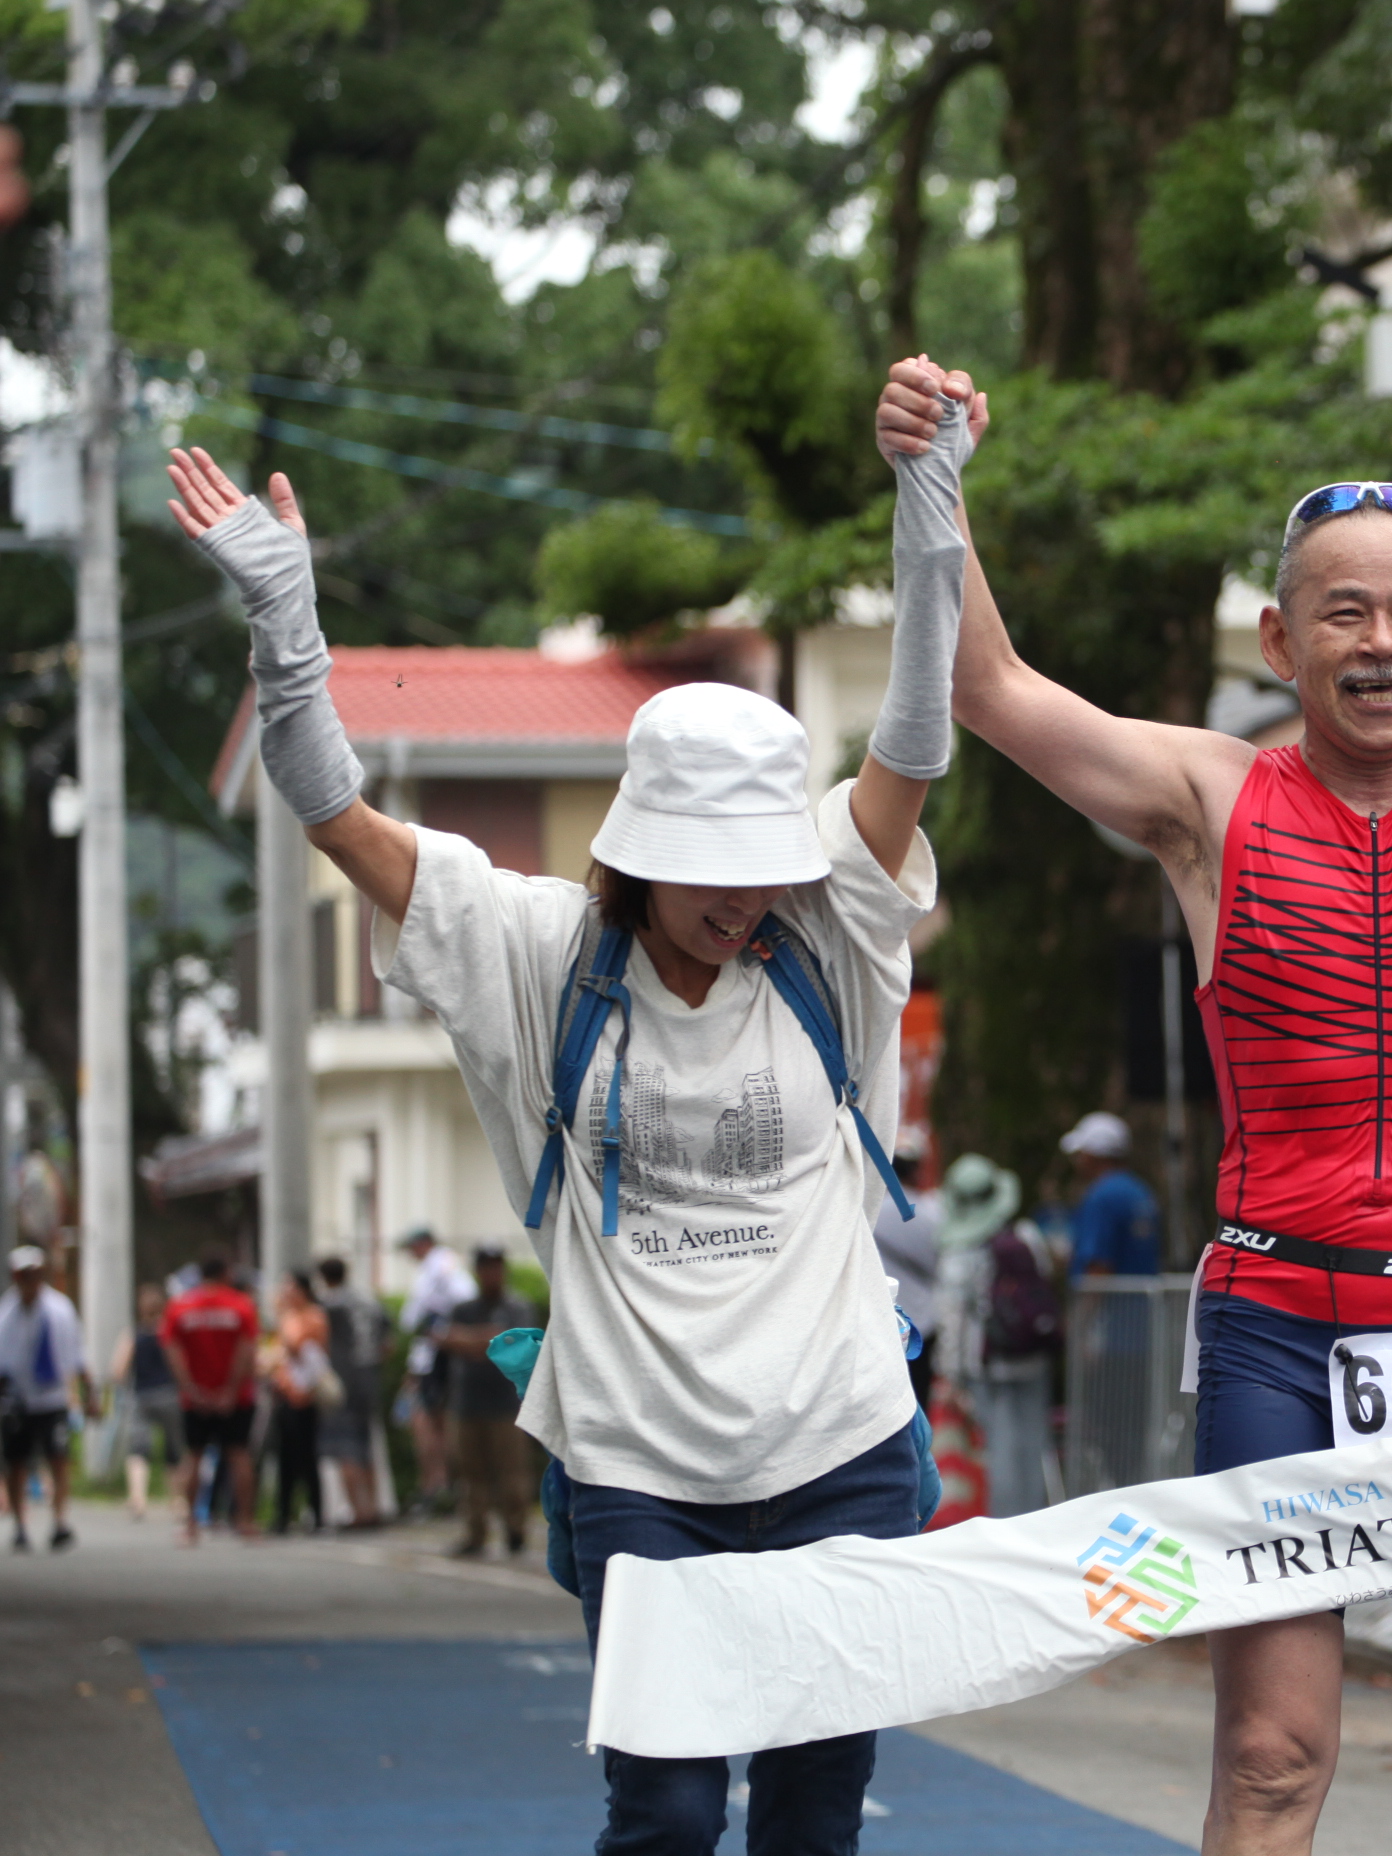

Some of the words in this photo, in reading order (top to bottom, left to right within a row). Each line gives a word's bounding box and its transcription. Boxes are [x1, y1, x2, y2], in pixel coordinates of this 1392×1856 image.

[631, 1230, 669, 1256] 5th
[676, 1224, 775, 1251] Avenue.
[1220, 1226, 1276, 1251] 2XU
[686, 1253, 709, 1265] CITY
[713, 1251, 725, 1261] OF
[728, 1249, 749, 1259] NEW
[751, 1246, 778, 1256] YORK
[1262, 1482, 1384, 1523] HIWASA
